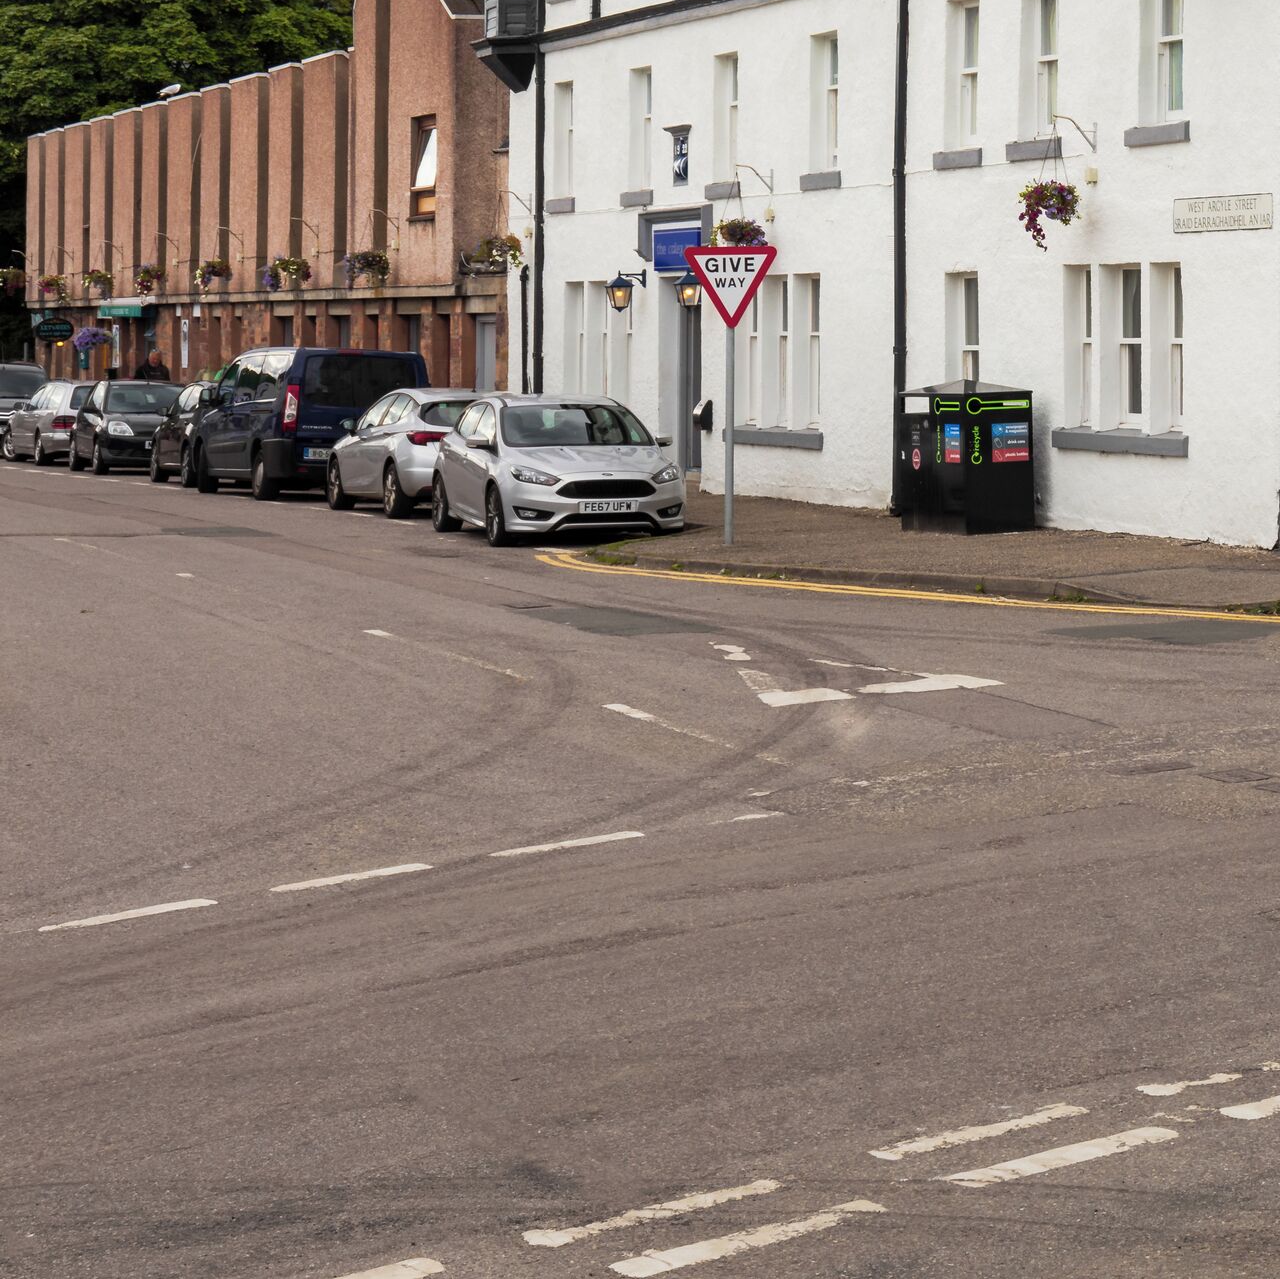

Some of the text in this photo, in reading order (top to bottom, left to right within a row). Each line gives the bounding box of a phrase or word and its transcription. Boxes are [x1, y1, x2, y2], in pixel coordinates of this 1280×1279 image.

[1187, 198, 1257, 213] WEST ARGYLE STREET
[705, 257, 755, 288] GIVE WAY
[973, 426, 981, 451] recycle
[584, 501, 632, 512] FE67 UFW
